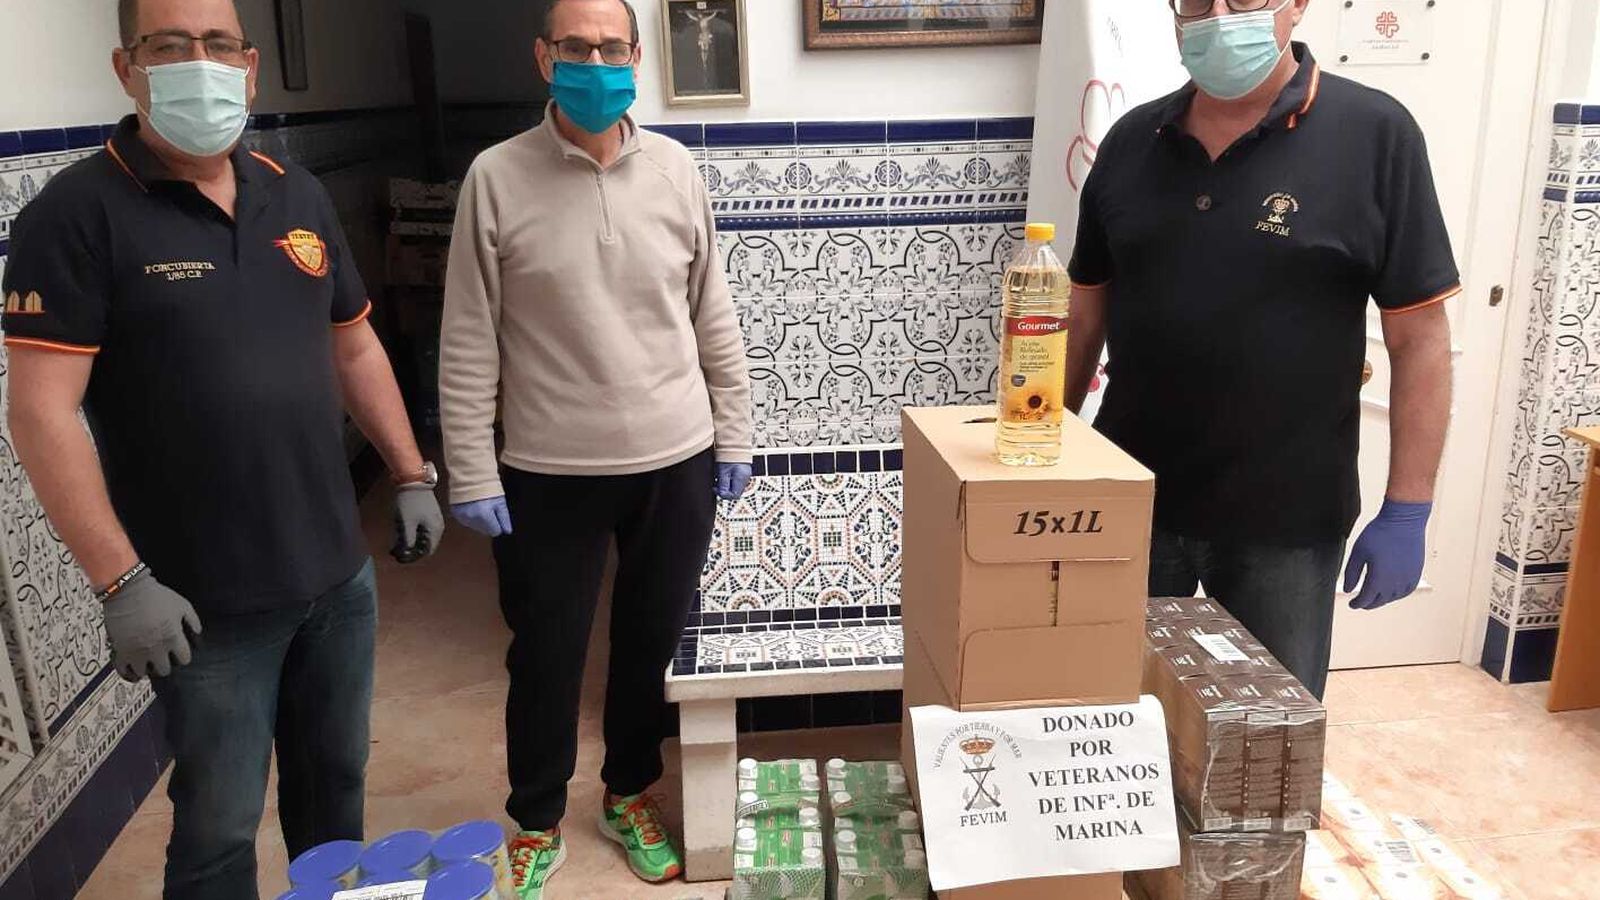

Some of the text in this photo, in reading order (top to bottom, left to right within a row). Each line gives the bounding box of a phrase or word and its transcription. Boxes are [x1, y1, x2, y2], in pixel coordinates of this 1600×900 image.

[1255, 221, 1290, 237] FEVIM
[1017, 321, 1060, 330] Gourmet
[1013, 510, 1103, 536] 15x1L
[1042, 711, 1134, 733] DONADO
[1070, 739, 1113, 757] POR
[1028, 763, 1160, 787] VETERANOS
[1038, 797, 1068, 815] DE
[1126, 790, 1155, 808] DE
[960, 810, 1008, 827] FEVIM
[1055, 820, 1143, 841] MARINA
